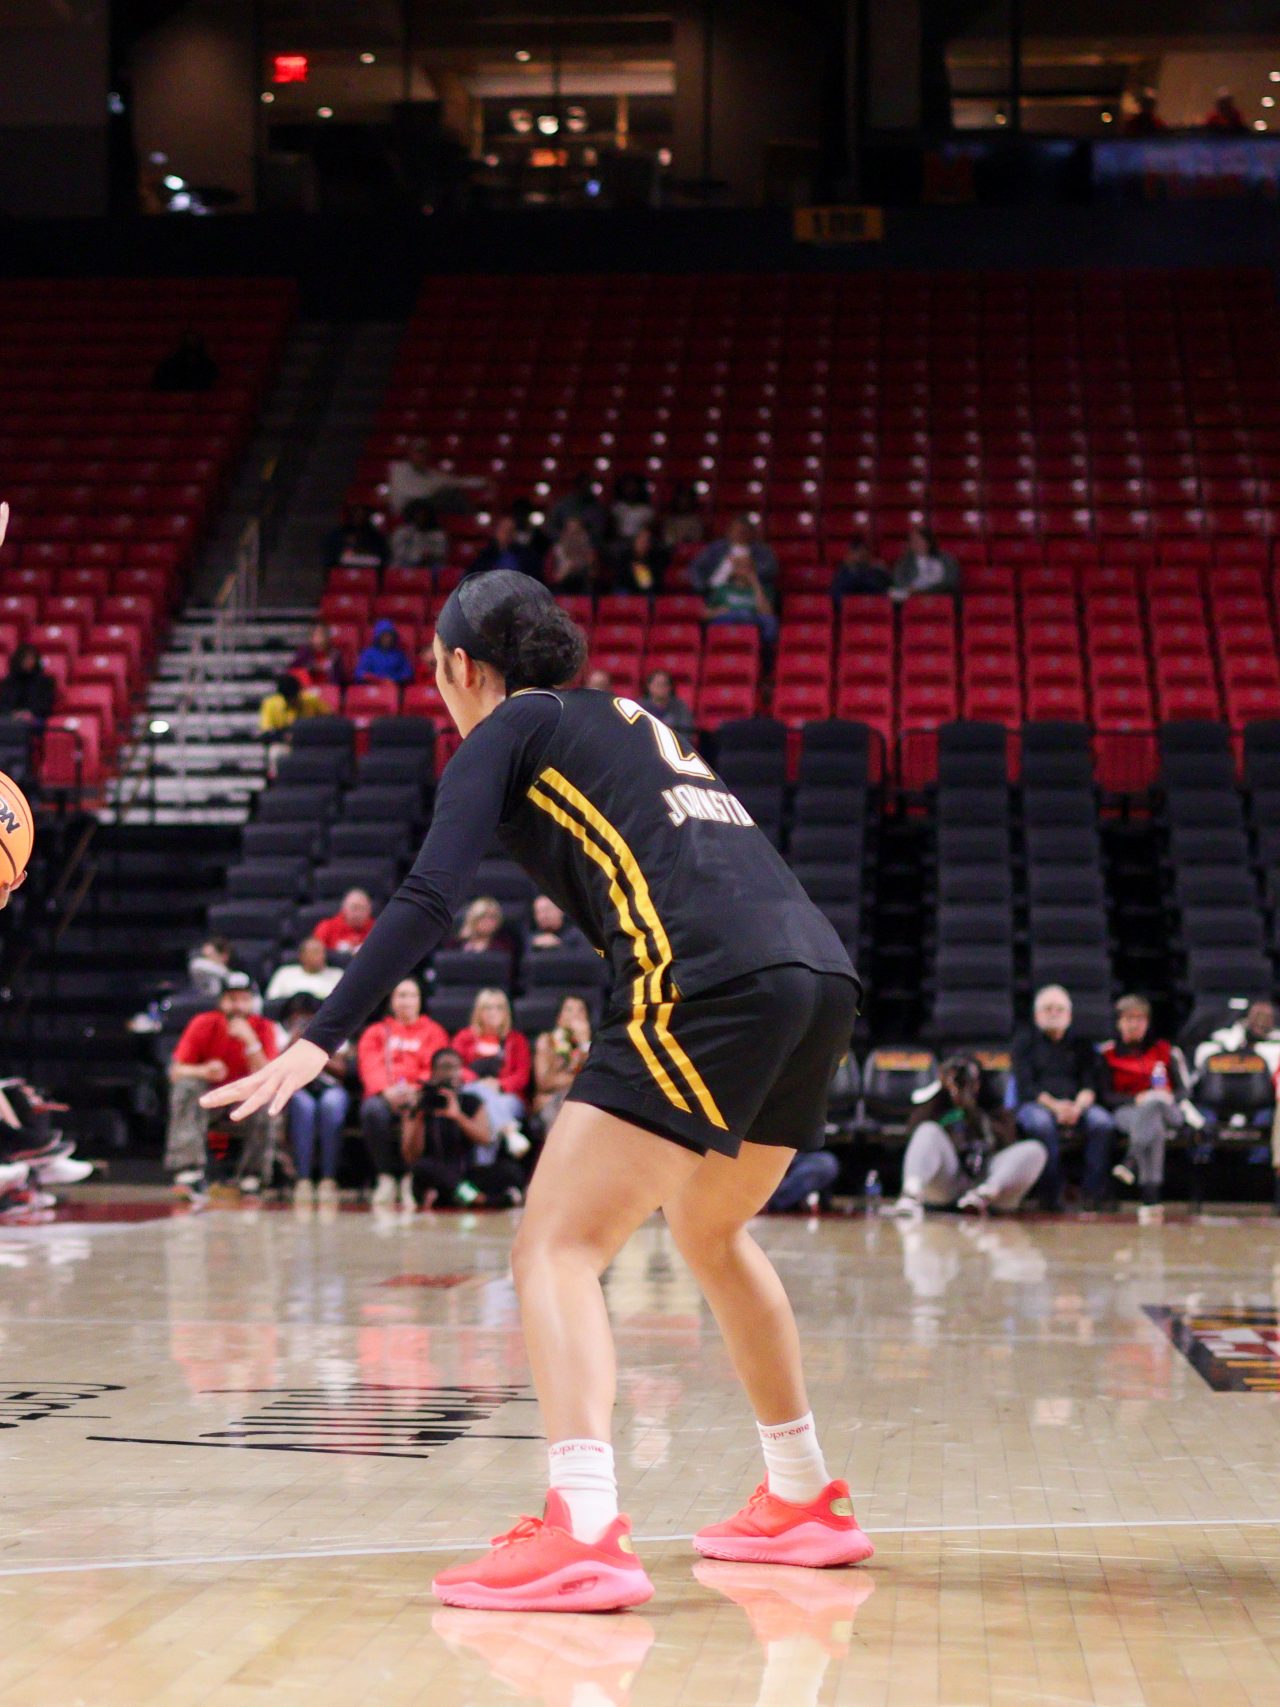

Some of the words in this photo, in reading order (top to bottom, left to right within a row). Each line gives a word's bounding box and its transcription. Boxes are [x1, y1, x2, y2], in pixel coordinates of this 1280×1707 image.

[613, 697, 716, 781] 2
[761, 1422, 810, 1440] Supreme
[550, 1443, 605, 1456] Supreme
